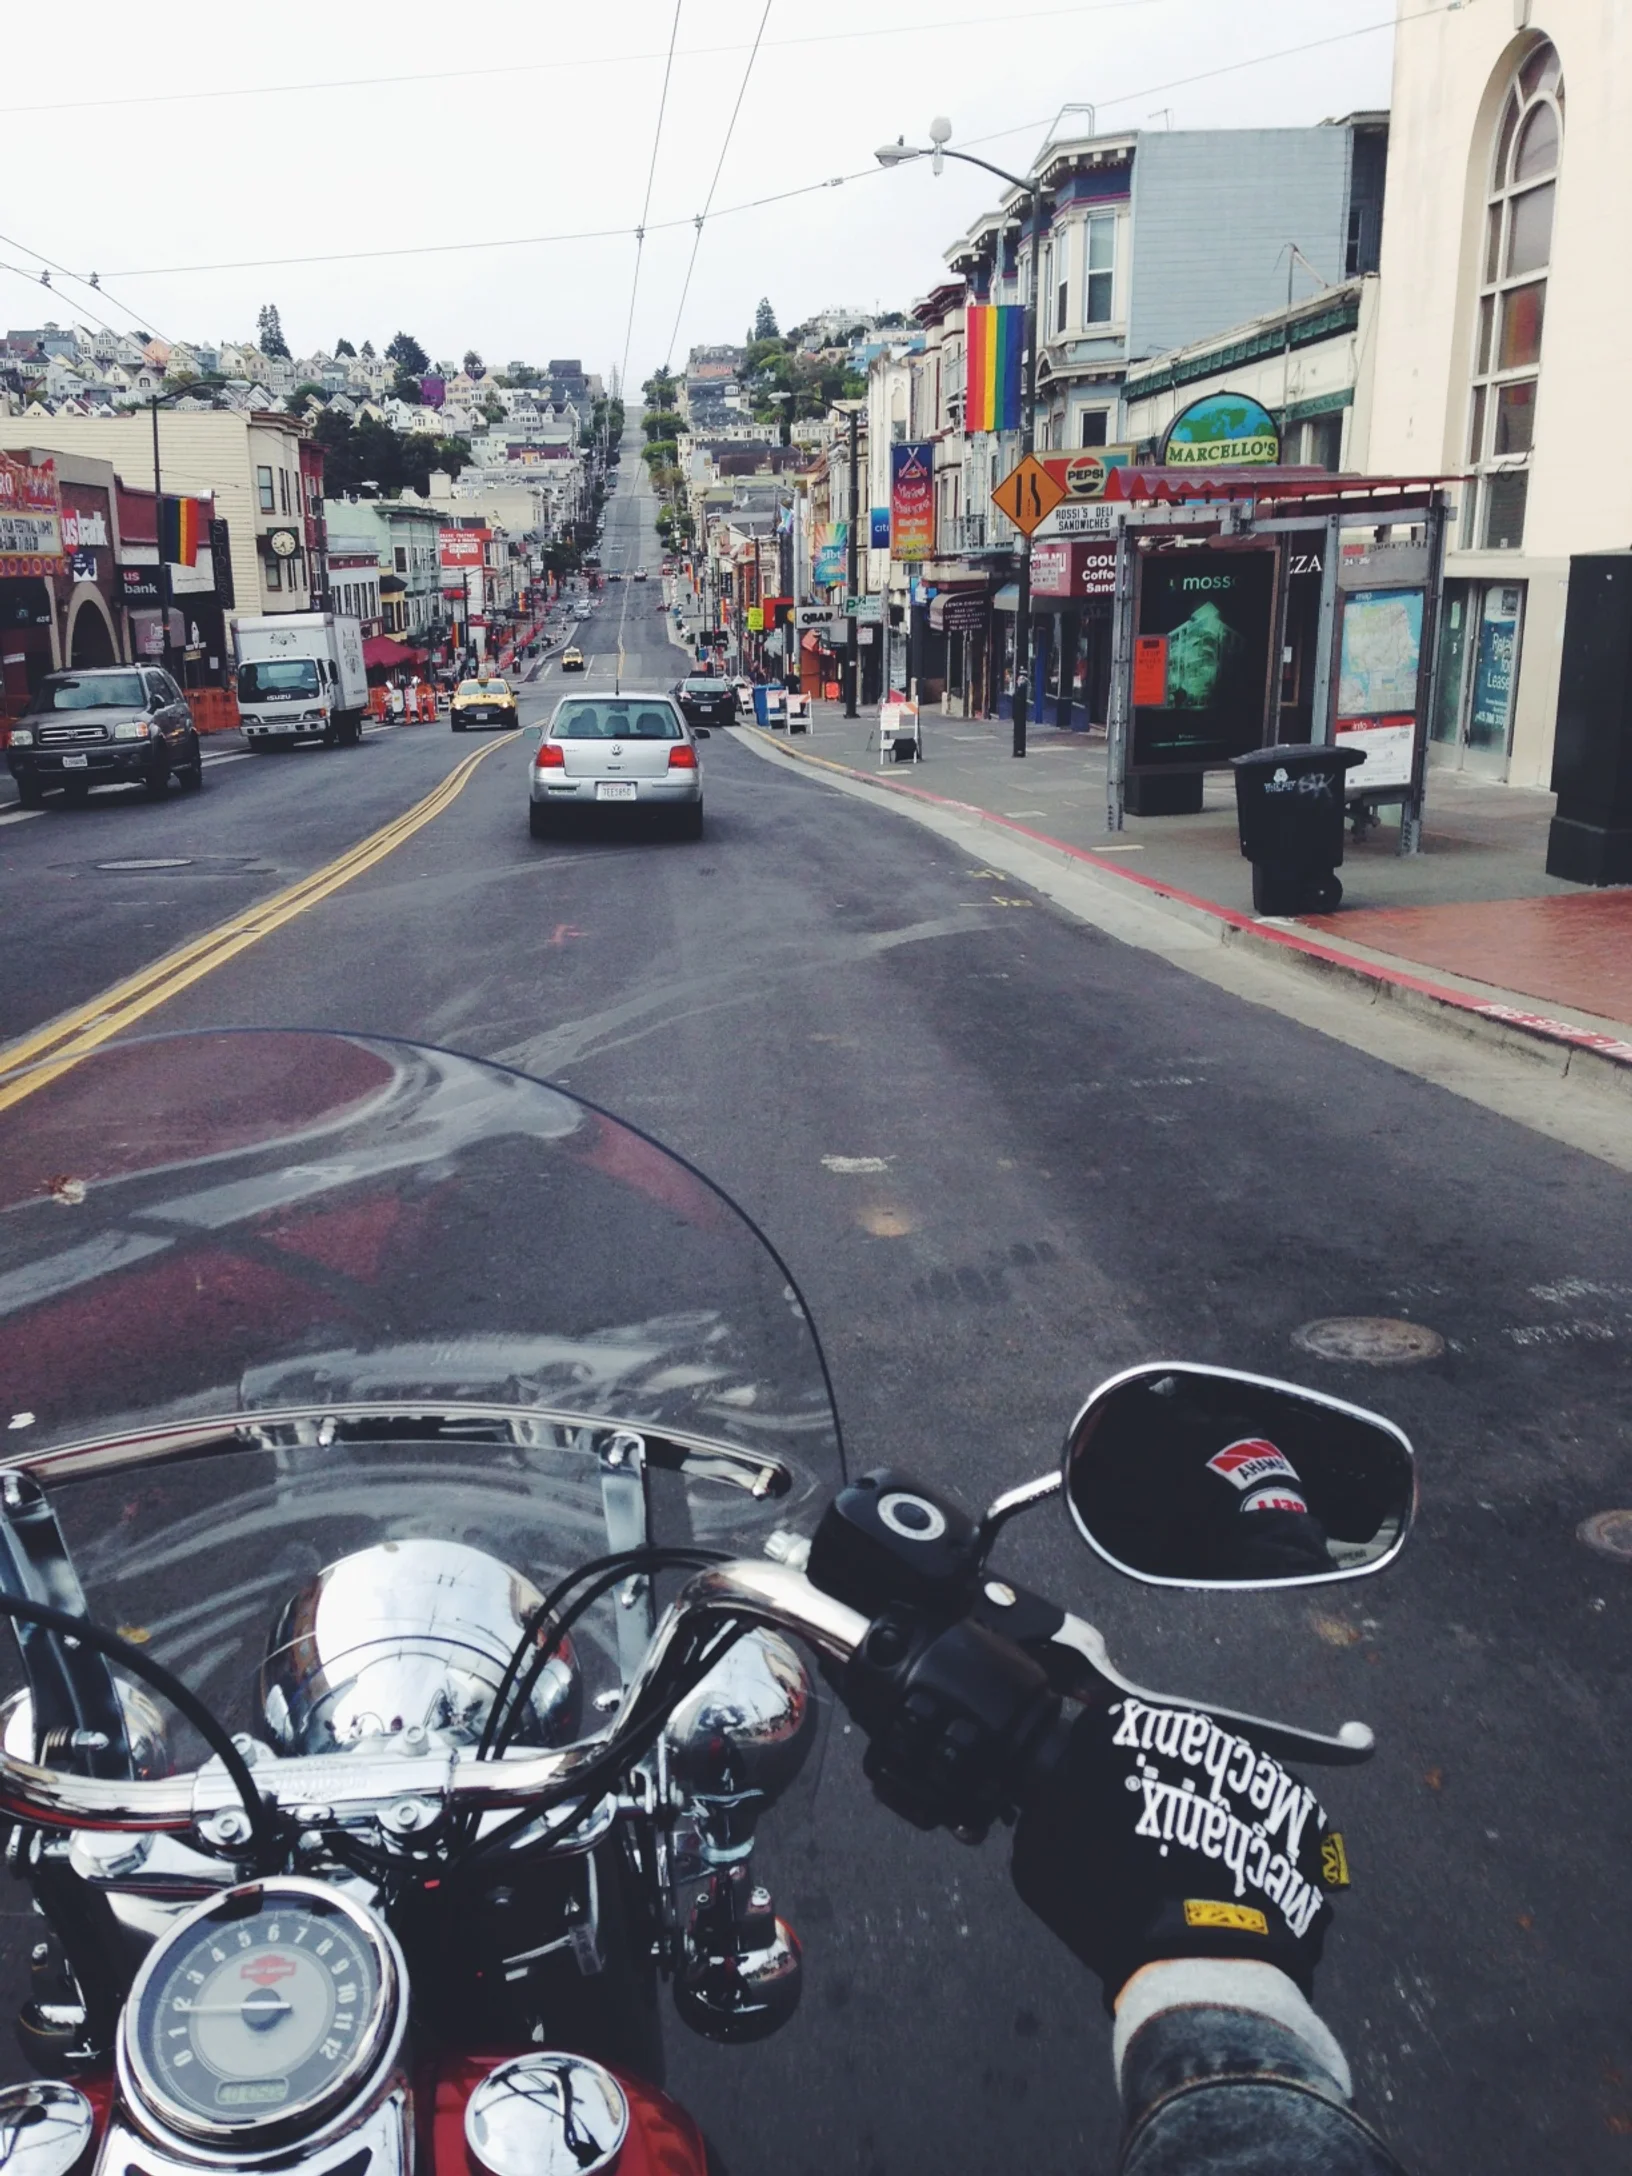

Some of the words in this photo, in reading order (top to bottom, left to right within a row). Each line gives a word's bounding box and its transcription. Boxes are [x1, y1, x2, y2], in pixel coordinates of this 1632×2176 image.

[1168, 441, 1276, 463] MARCELLO'S
[1067, 469, 1104, 481] PEPSI
[1055, 506, 1088, 519] ROSSI'S
[1095, 506, 1114, 518] DELI
[76, 510, 108, 546] bank
[1058, 517, 1111, 532] SANDWICHES
[1087, 555, 1127, 567] GOU
[123, 571, 140, 581] us
[1082, 570, 1117, 581] Coffe
[124, 583, 158, 594] bank
[1086, 582, 1126, 593] Sand
[1356, 592, 1372, 601] map
[846, 599, 856, 613] P
[1352, 721, 1367, 730] info
[1112, 1698, 1322, 1860] Mechanix
[1135, 1779, 1323, 1938] Mechanix
[237, 1930, 251, 1948] 5
[267, 1923, 280, 1942] 6
[294, 1925, 308, 1944] 7
[211, 1946, 226, 1962] 4
[315, 1937, 334, 1956] 8
[330, 1957, 350, 1976] 9
[186, 1969, 205, 1985] 3
[337, 1982, 357, 2004] 10
[333, 2012, 354, 2030] 11
[168, 2026, 187, 2039] 1
[319, 2037, 343, 2060] 12
[172, 2049, 193, 2067] 0
